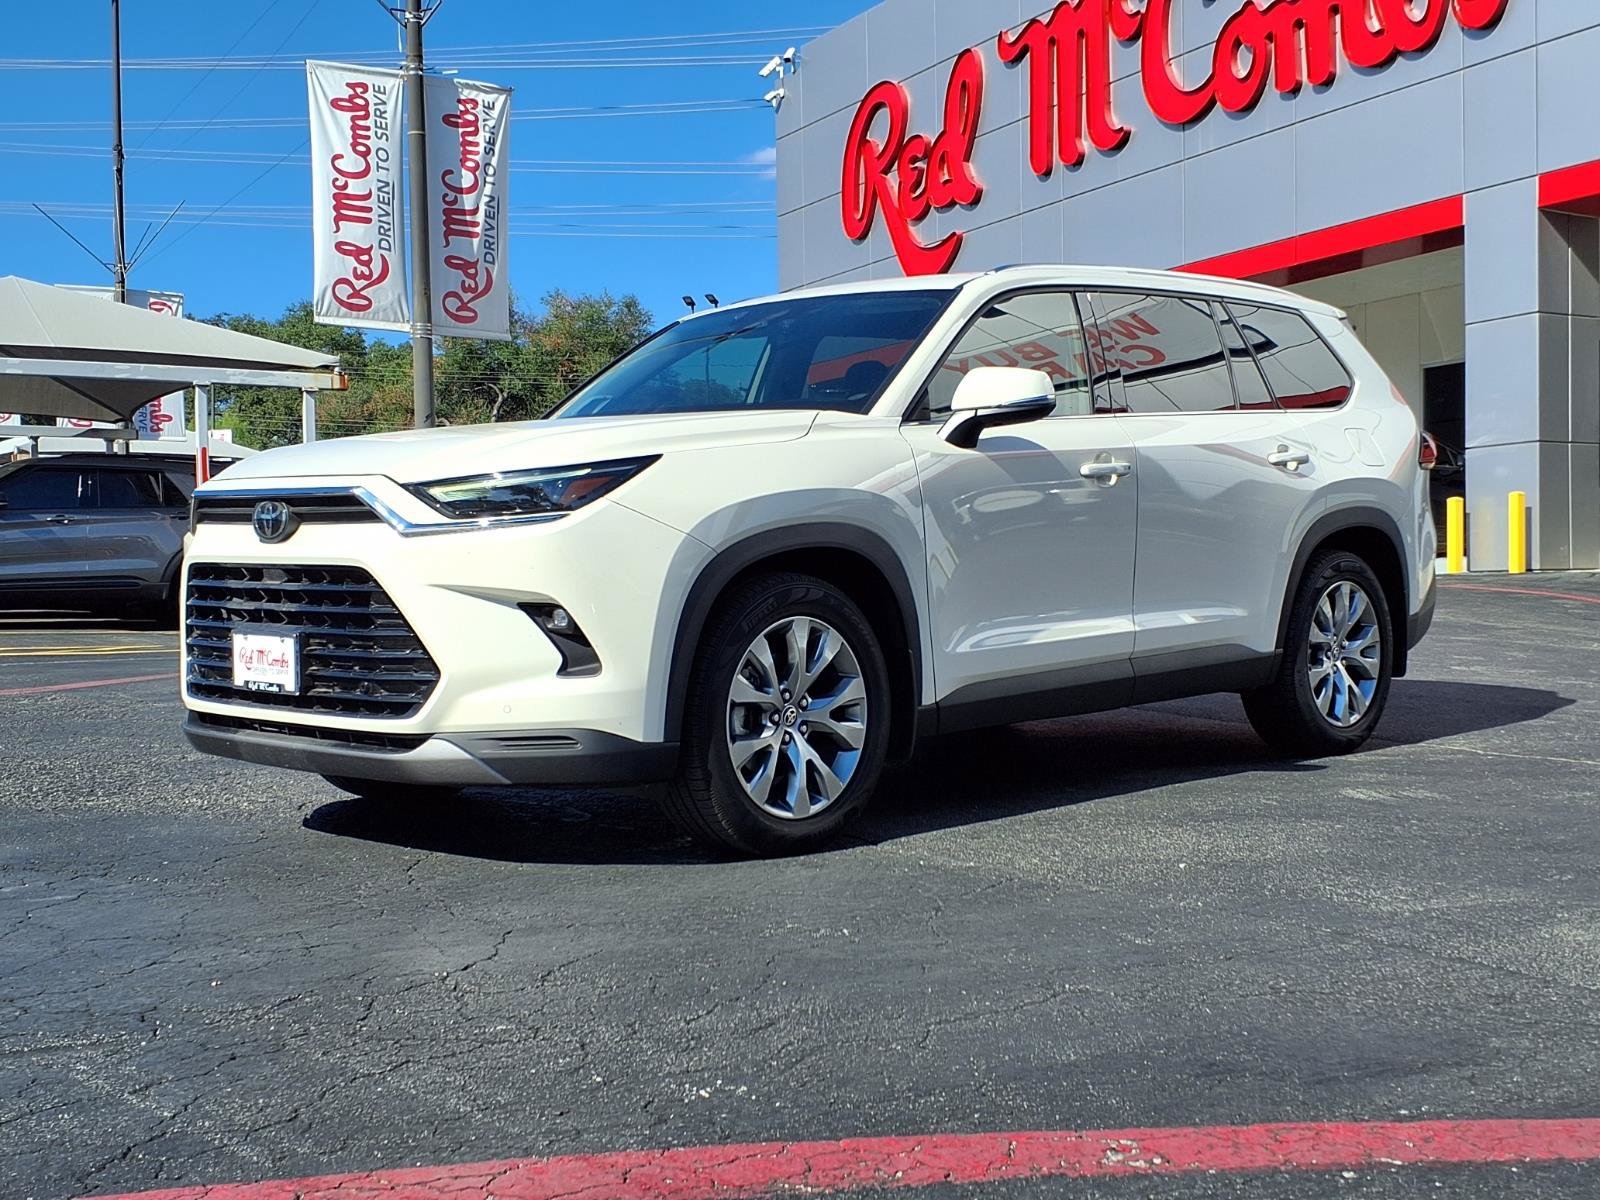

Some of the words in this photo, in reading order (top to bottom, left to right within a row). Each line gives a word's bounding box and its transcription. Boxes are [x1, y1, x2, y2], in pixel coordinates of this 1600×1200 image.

[372, 83, 389, 143] SERVE
[482, 98, 497, 158] SERVE
[329, 81, 373, 233] McCombs
[375, 146, 391, 177] TO
[441, 97, 481, 249] McCombs
[483, 160, 497, 188] TO
[842, 48, 984, 275] Red
[377, 179, 393, 253] DRIVEN
[483, 194, 496, 266] DRIVEN
[331, 240, 390, 313] Red
[441, 254, 494, 324] Red
[136, 404, 148, 433] ERVE
